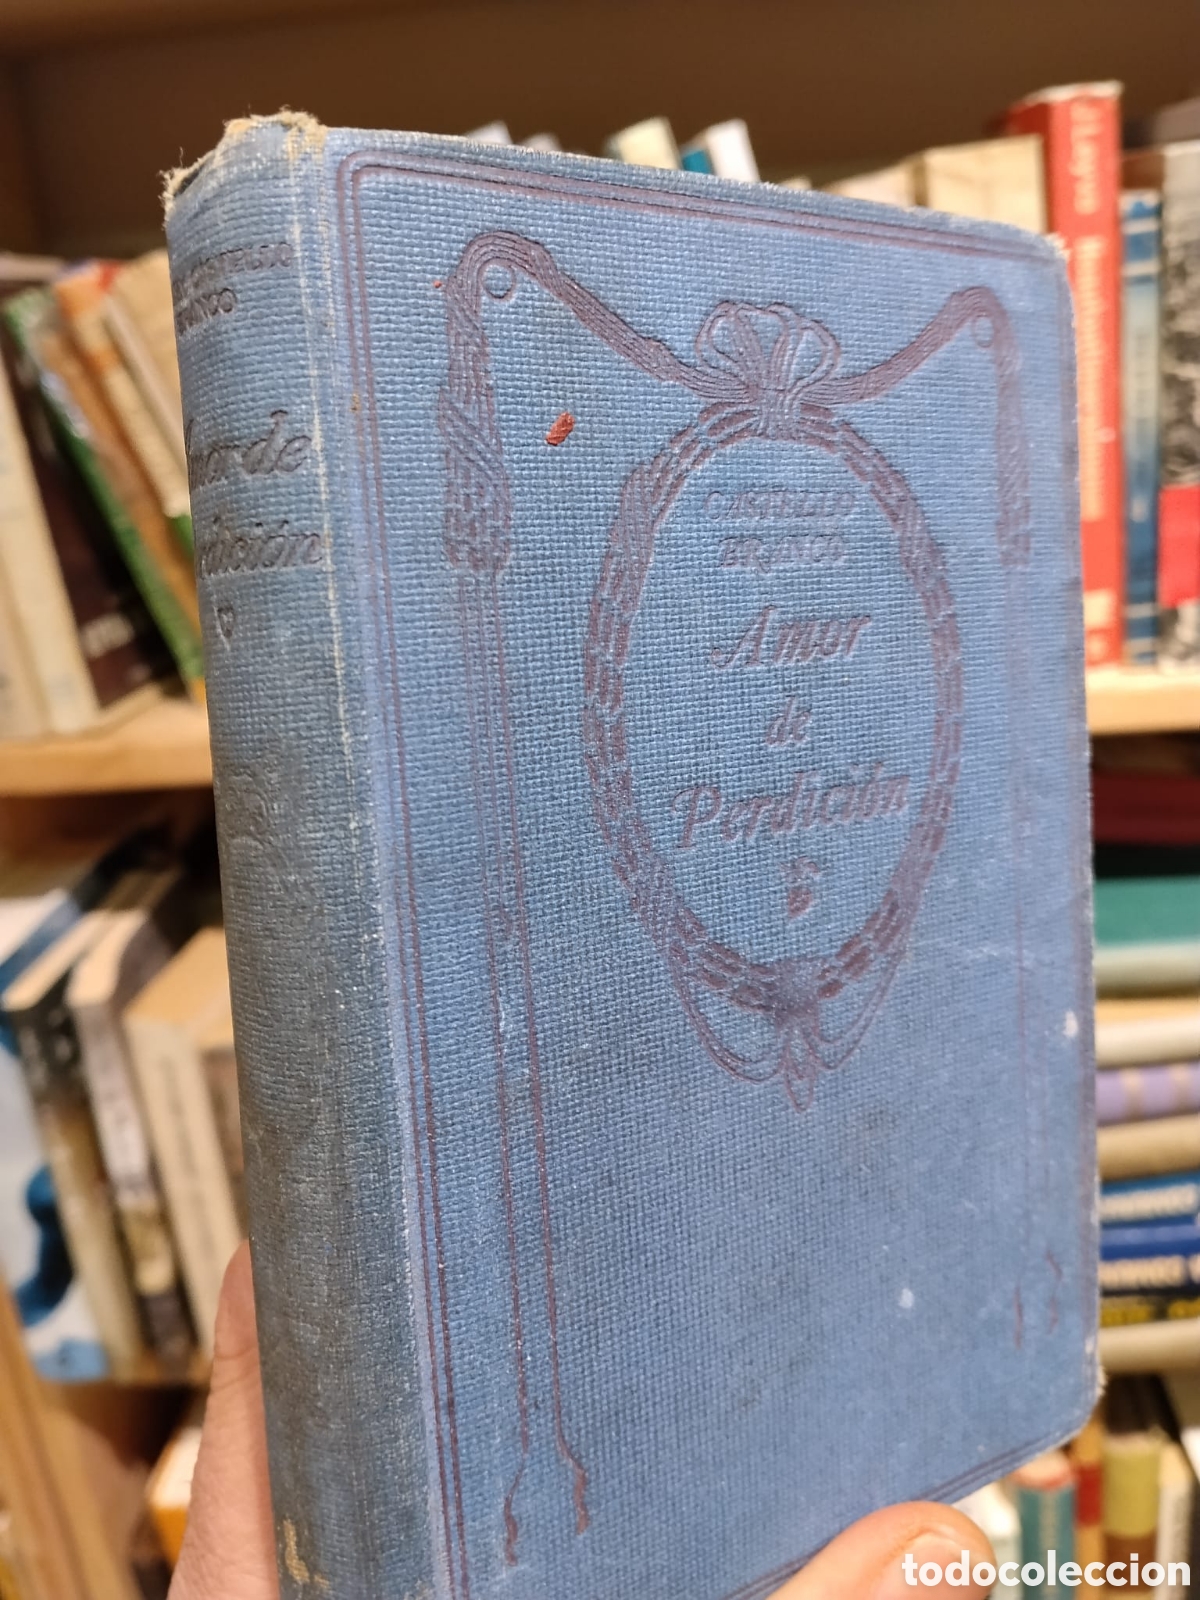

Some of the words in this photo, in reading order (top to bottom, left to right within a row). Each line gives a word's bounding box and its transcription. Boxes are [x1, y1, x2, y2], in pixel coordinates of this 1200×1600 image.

[242, 410, 313, 474] de
[719, 534, 846, 574] BRANCO
[710, 604, 872, 669] Amor
[765, 695, 812, 745] de
[672, 761, 909, 848] Perdición
